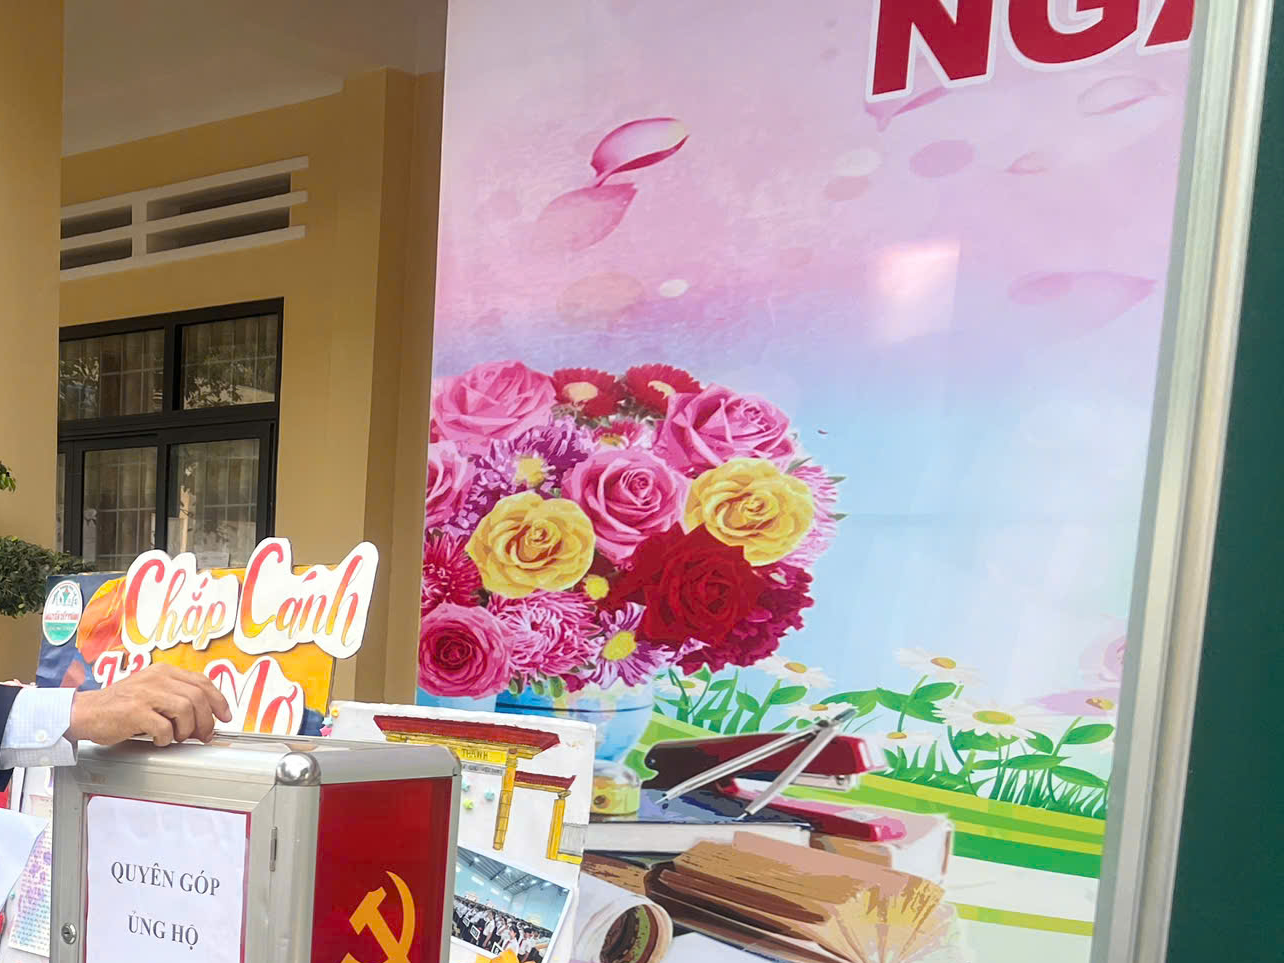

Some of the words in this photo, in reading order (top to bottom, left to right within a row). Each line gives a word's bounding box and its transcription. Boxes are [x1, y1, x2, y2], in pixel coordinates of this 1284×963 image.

[124, 559, 227, 646] Chắp
[239, 542, 364, 648] Cánh
[208, 658, 299, 736] Mơ
[111, 861, 175, 888] QUYÊN
[179, 869, 221, 896] GÓP
[127, 910, 166, 939] ỦNG
[171, 924, 199, 951] HỘ
